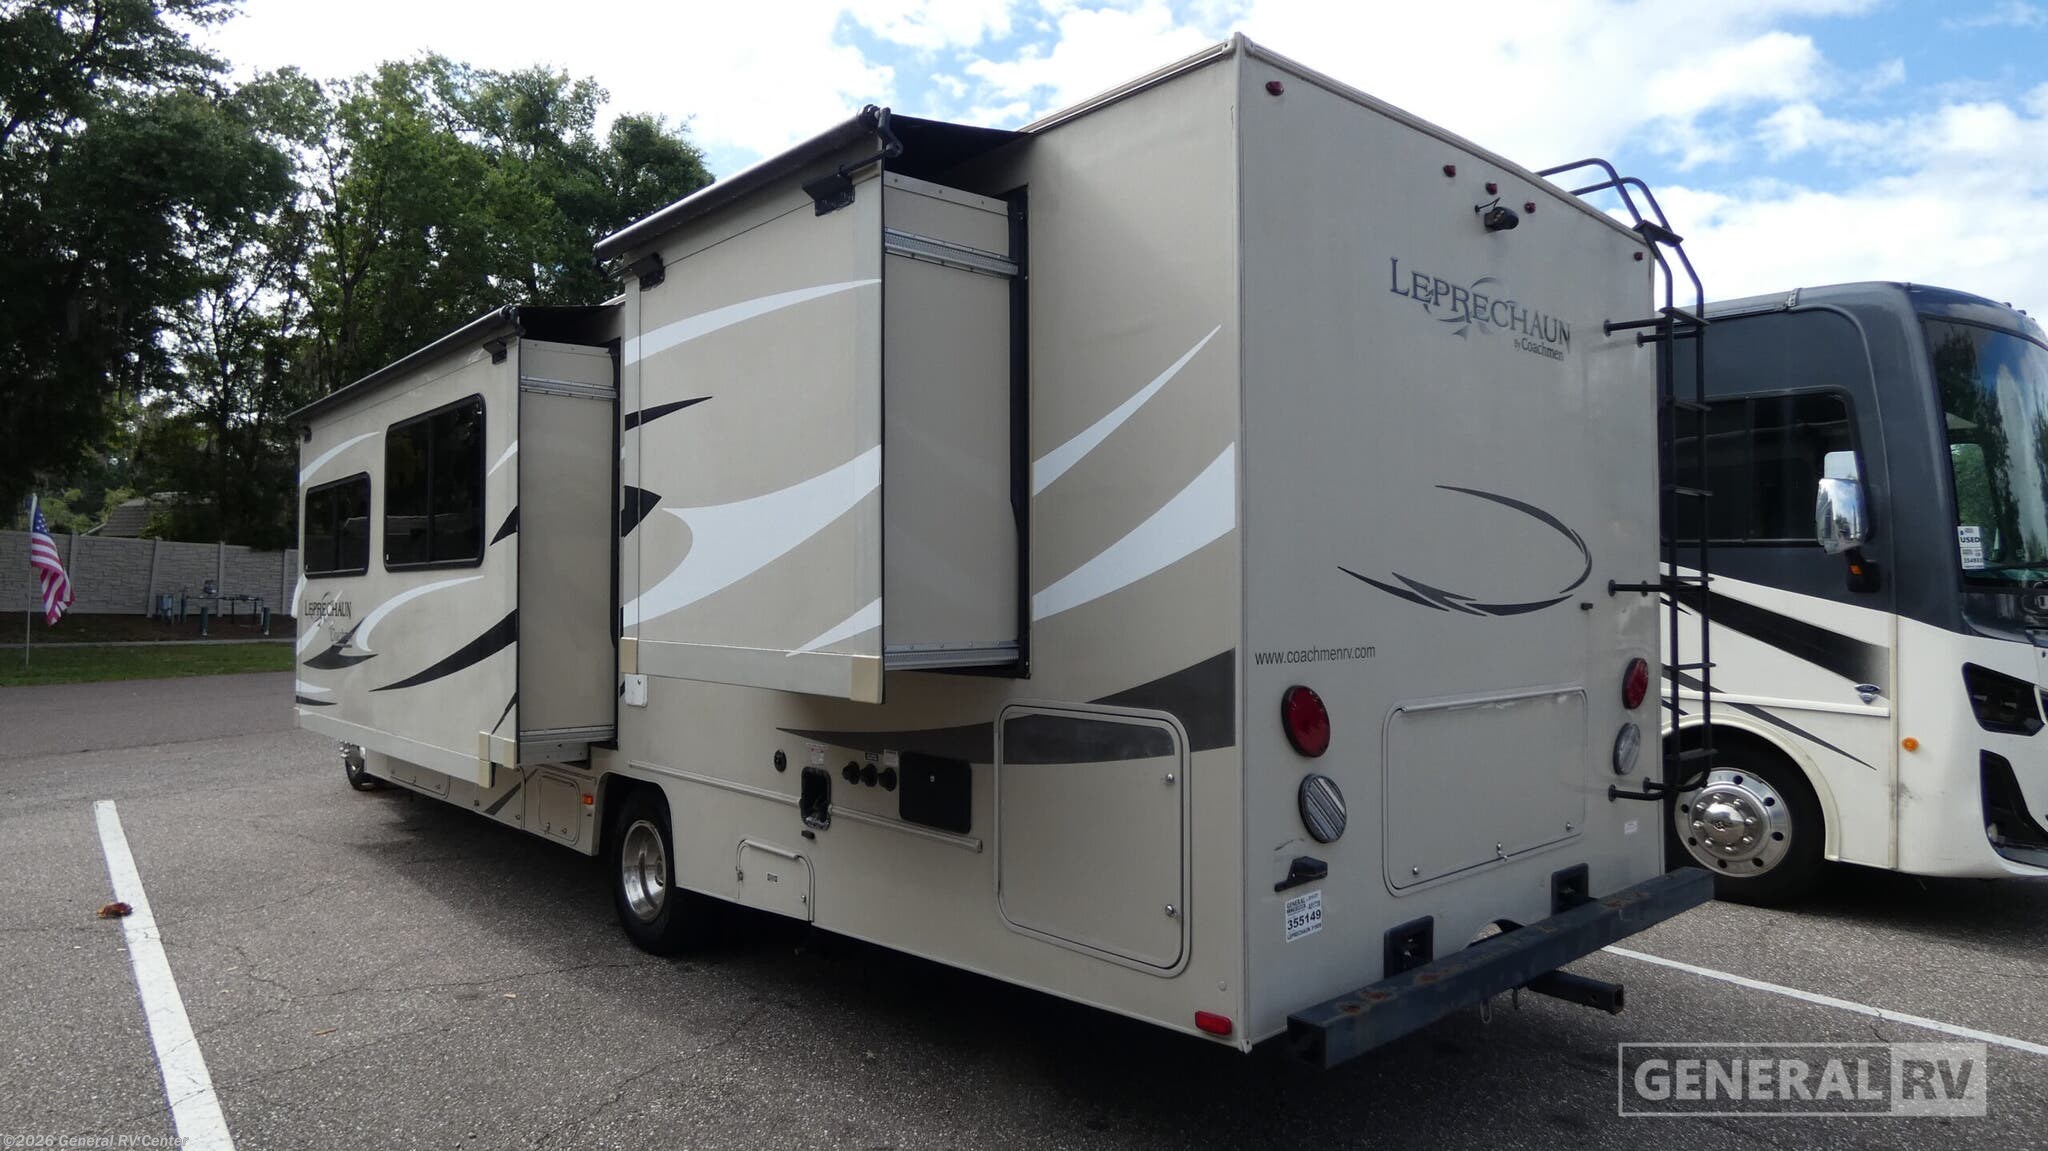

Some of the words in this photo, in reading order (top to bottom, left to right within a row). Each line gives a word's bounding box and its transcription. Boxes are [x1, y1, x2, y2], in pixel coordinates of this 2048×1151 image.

[1390, 256, 1571, 353] LEPRECHAUN
[1521, 337, 1564, 361] Coachmen
[304, 600, 352, 619] LEPRECHAUN
[1255, 645, 1376, 665] www.coachmenrv.com
[1287, 909, 1321, 930] 355149
